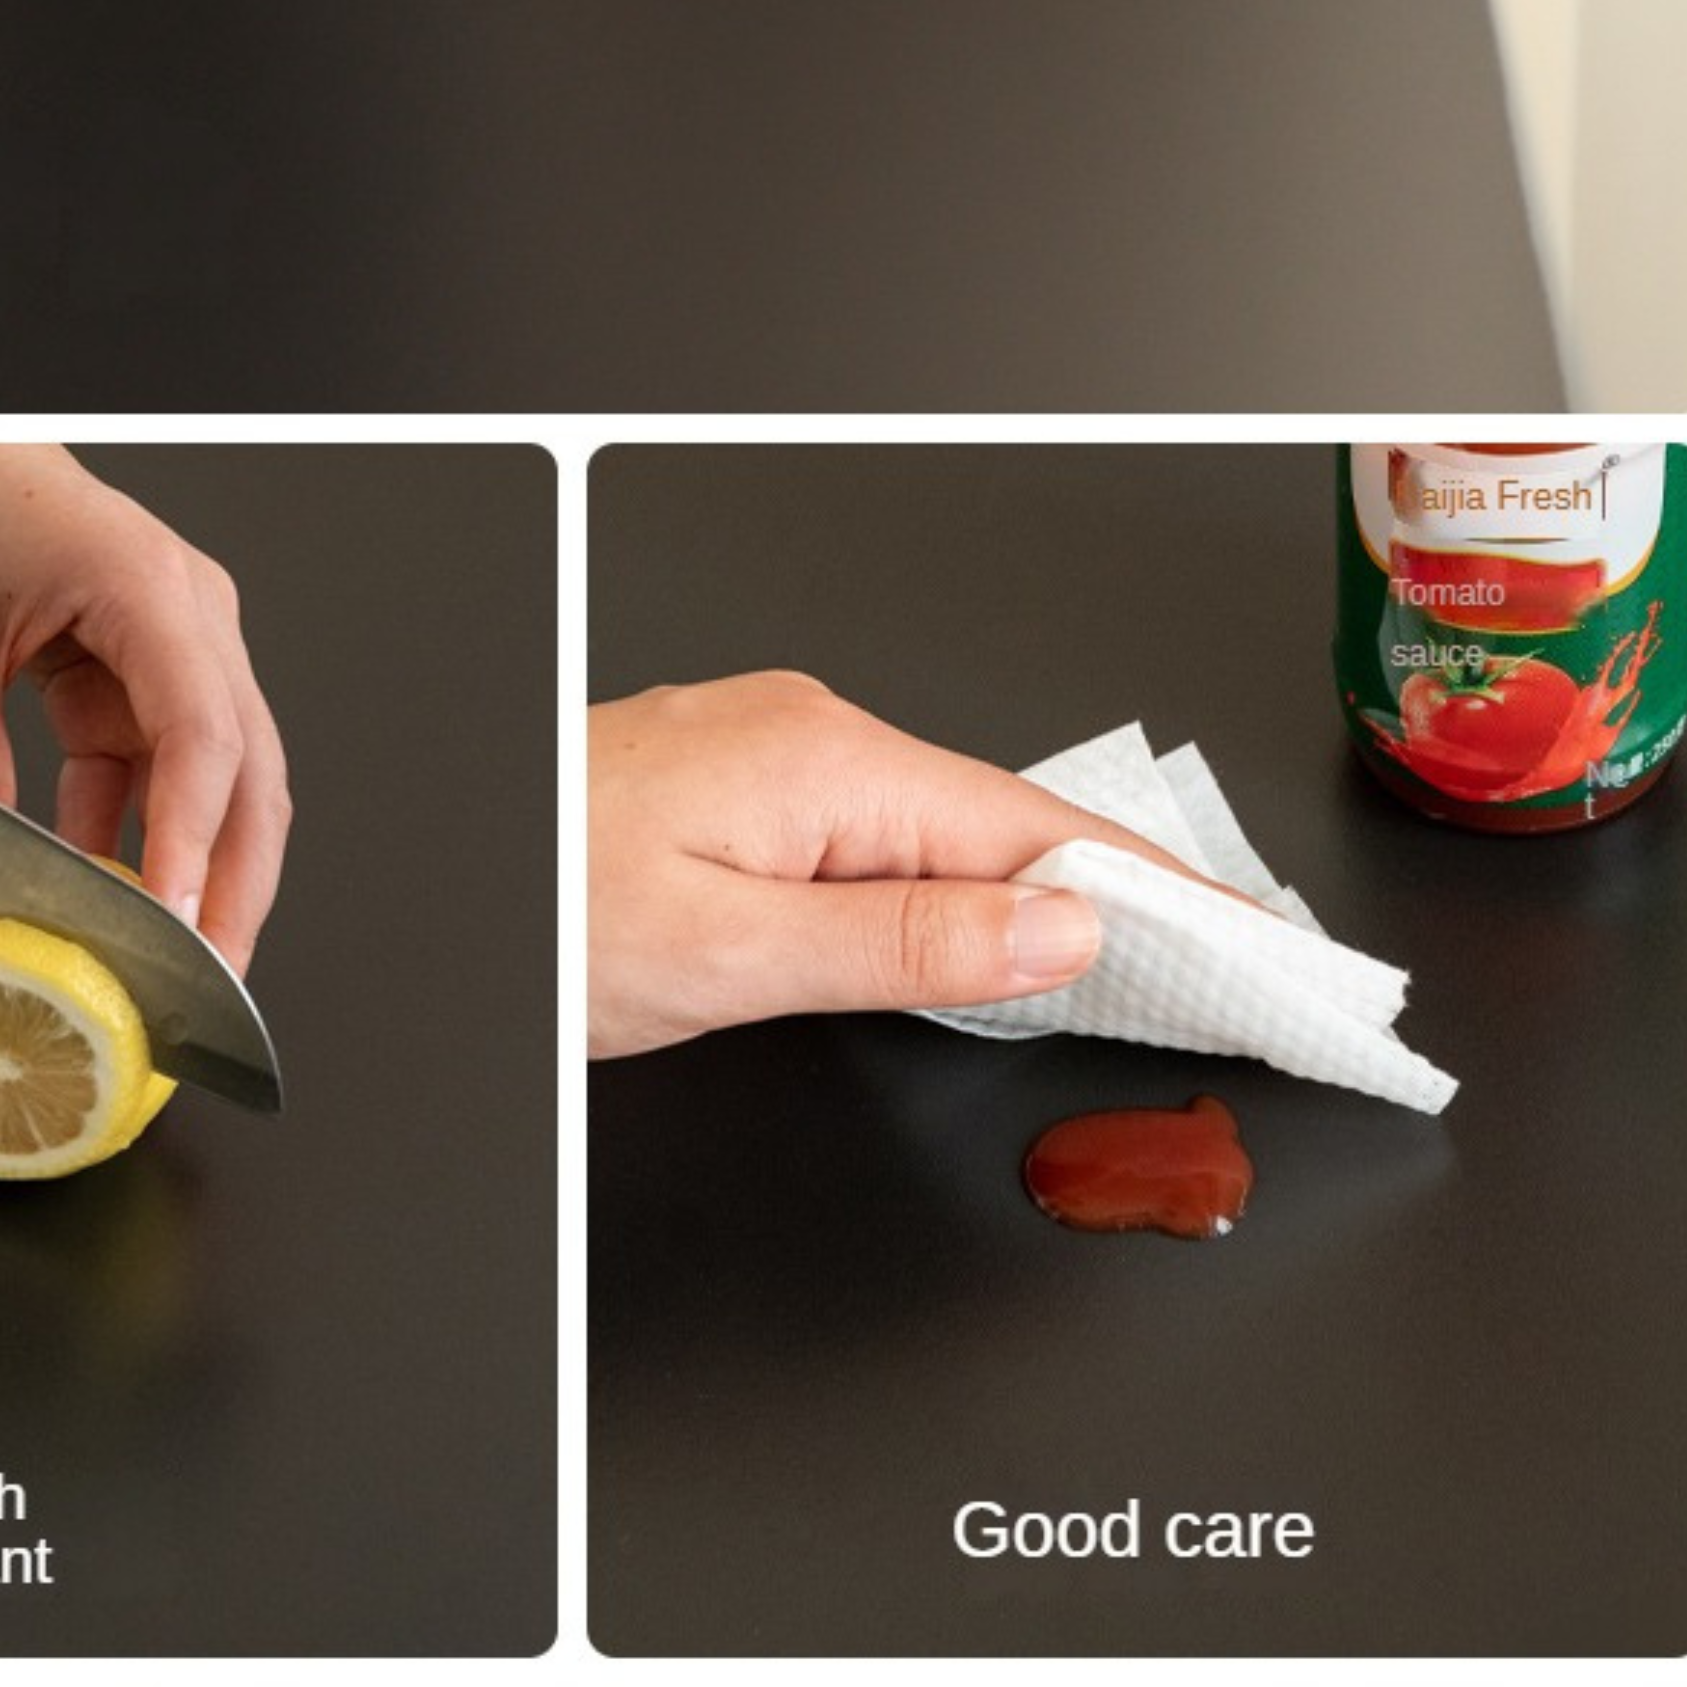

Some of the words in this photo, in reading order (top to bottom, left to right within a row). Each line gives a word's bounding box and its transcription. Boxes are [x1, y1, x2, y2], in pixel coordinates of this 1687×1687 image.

[1396, 478, 1487, 519] aijia
[1497, 479, 1593, 511] Fresh
[1391, 577, 1506, 607] Tomato
[1390, 642, 1485, 668] sauce
